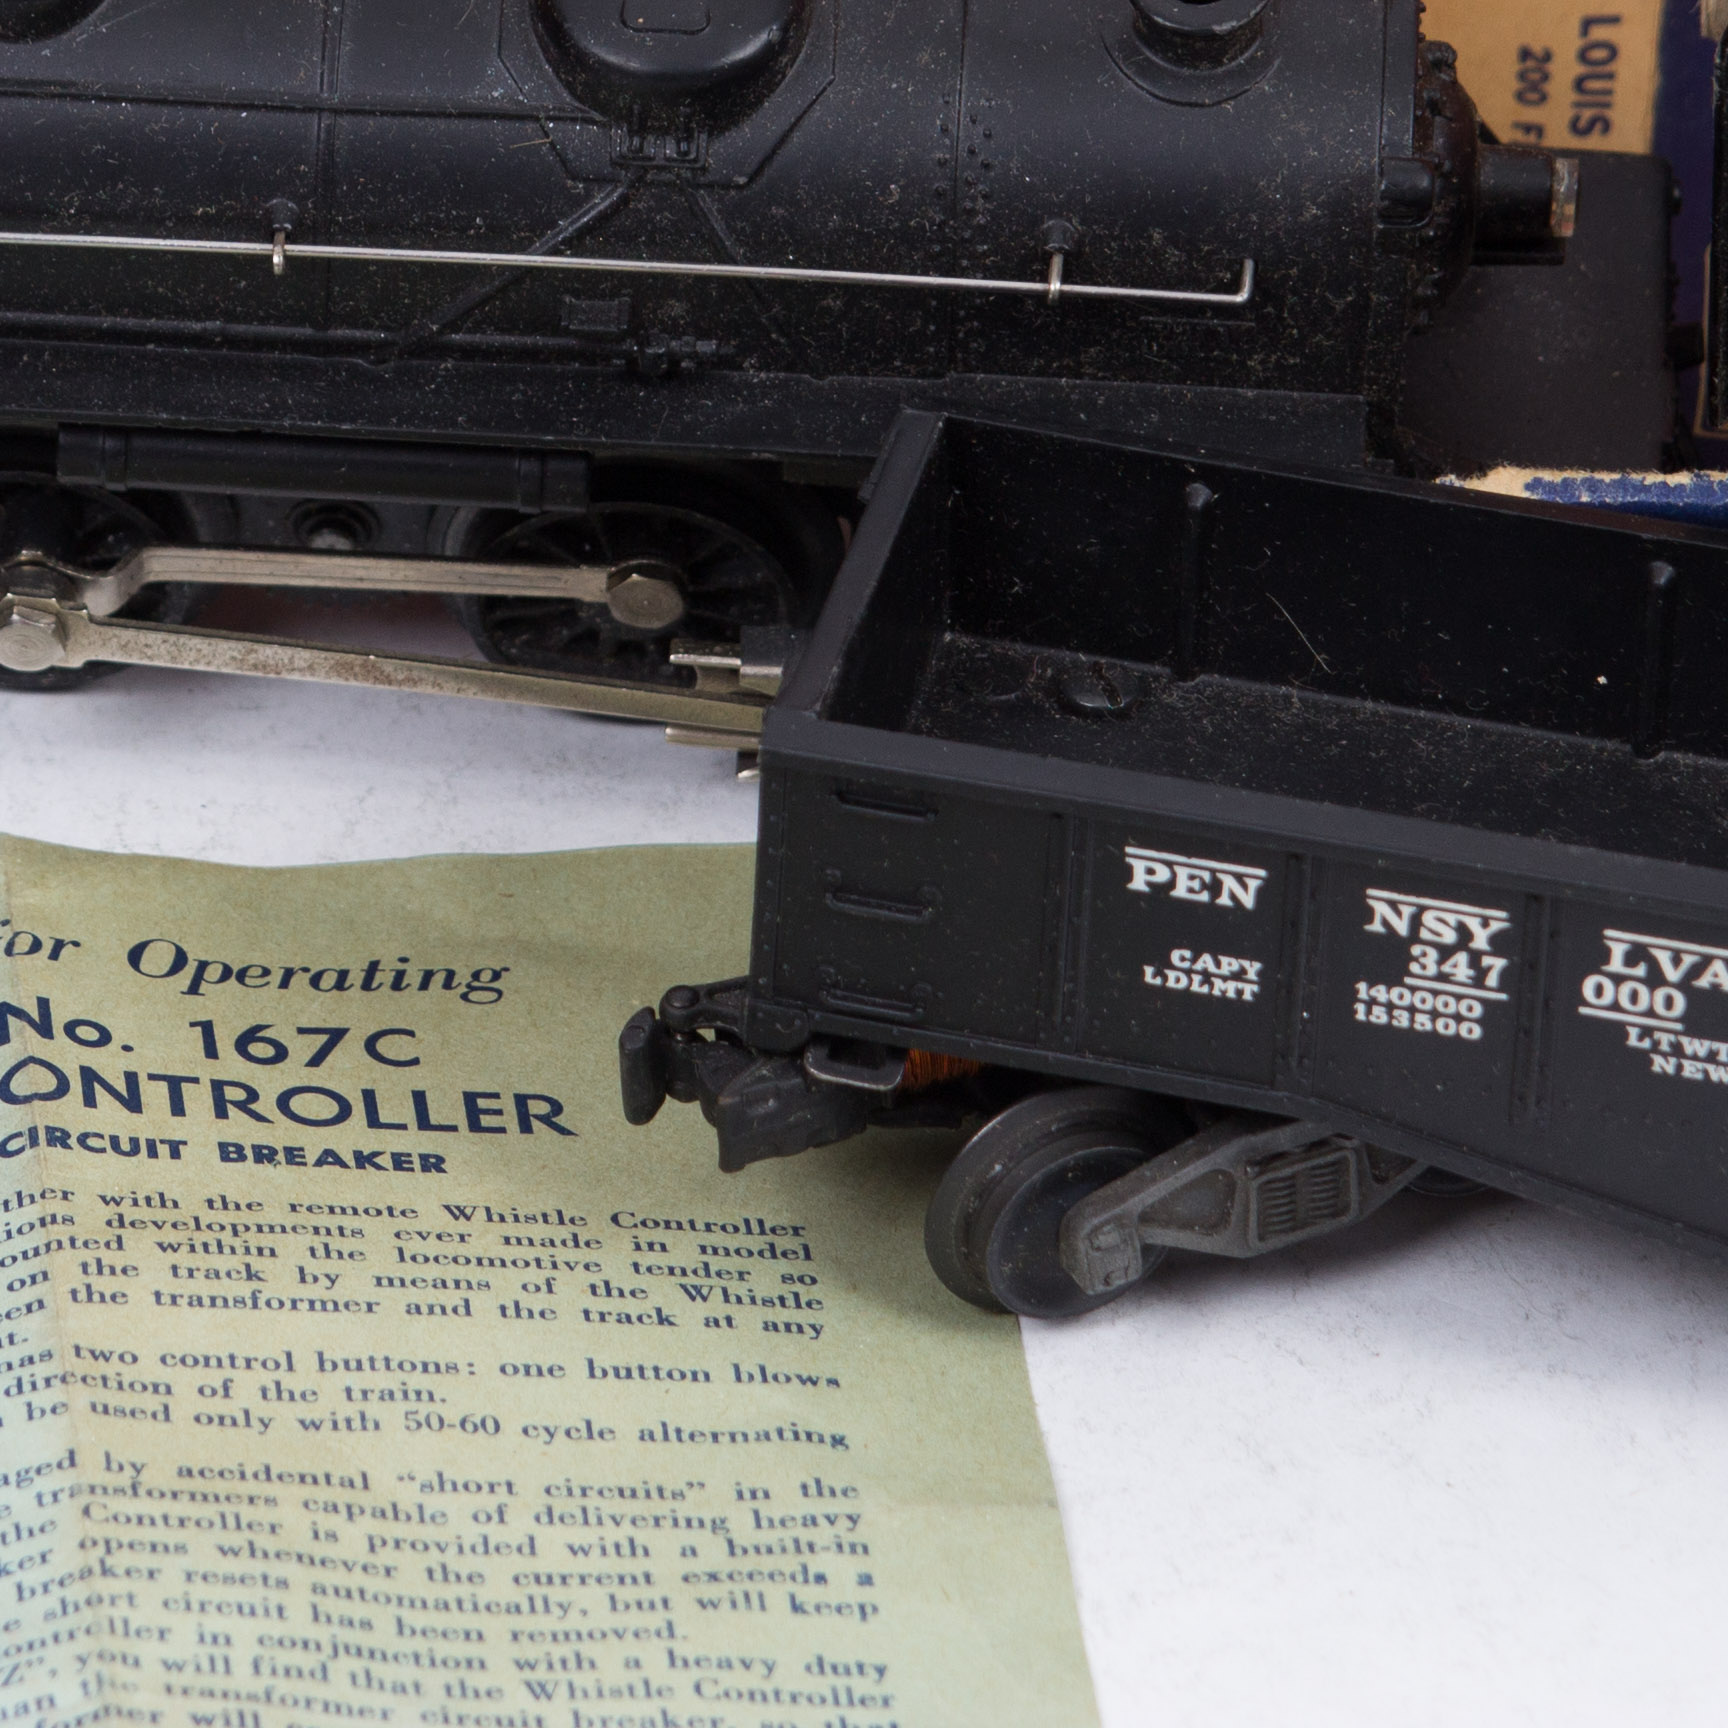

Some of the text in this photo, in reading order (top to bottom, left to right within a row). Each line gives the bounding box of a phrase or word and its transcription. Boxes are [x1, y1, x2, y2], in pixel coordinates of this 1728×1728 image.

[1513, 44, 1553, 106] 200
[1568, 13, 1622, 138] LOUIS
[1124, 856, 1264, 911] PEN
[1363, 897, 1511, 952] NSY
[126, 937, 512, 1005] Operating
[1170, 948, 1263, 982] CAPY
[1354, 980, 1484, 1020] 140000
[1408, 943, 1687, 1020] 347 000
[1142, 965, 1261, 1002] LDLMT
[1353, 1002, 1483, 1041] 153500
[189, 1019, 422, 1069] 167C
[218, 1140, 449, 1174] BREAKER
[95, 1190, 182, 1211] with
[202, 1194, 266, 1213] the
[287, 1202, 421, 1220] remote
[440, 1204, 590, 1228] Whistle
[608, 1211, 809, 1239] Controller
[104, 1212, 367, 1240] developments
[392, 1230, 475, 1245] ever
[499, 1231, 605, 1251] made
[630, 1235, 672, 1255] in
[696, 1241, 816, 1263] model
[5, 1269, 52, 1294] on
[79, 1257, 141, 1278] the
[169, 1262, 269, 1284] track
[296, 1265, 342, 1292] by
[373, 1275, 493, 1292] means
[520, 1276, 559, 1296] of
[587, 1279, 651, 1301] the
[677, 1282, 825, 1312] Whistle
[153, 1237, 281, 1259] within
[307, 1241, 368, 1262] the
[395, 1246, 605, 1274] locomotive
[628, 1260, 754, 1283] tender
[779, 1273, 821, 1288] so
[68, 1282, 130, 1306] the
[152, 1289, 383, 1315] transformer
[404, 1297, 475, 1318] and
[497, 1299, 559, 1322] the
[581, 1306, 680, 1328] track
[702, 1314, 737, 1330] at
[761, 1320, 826, 1341] any
[2, 1371, 175, 1399] direction
[196, 1378, 236, 1400] of
[259, 1380, 320, 1403] the
[343, 1381, 449, 1404] train.
[72, 1344, 141, 1366] two
[158, 1350, 297, 1374] control
[315, 1350, 478, 1377] buttons:
[498, 1363, 567, 1379] one
[585, 1357, 713, 1384] button
[731, 1362, 843, 1390] blows
[25, 1401, 70, 1422] be
[89, 1401, 173, 1424] used
[192, 1408, 274, 1434] only
[296, 1410, 382, 1433] with
[403, 1410, 503, 1436] 50-60
[520, 1419, 618, 1446] cycle
[637, 1421, 852, 1451] alternating
